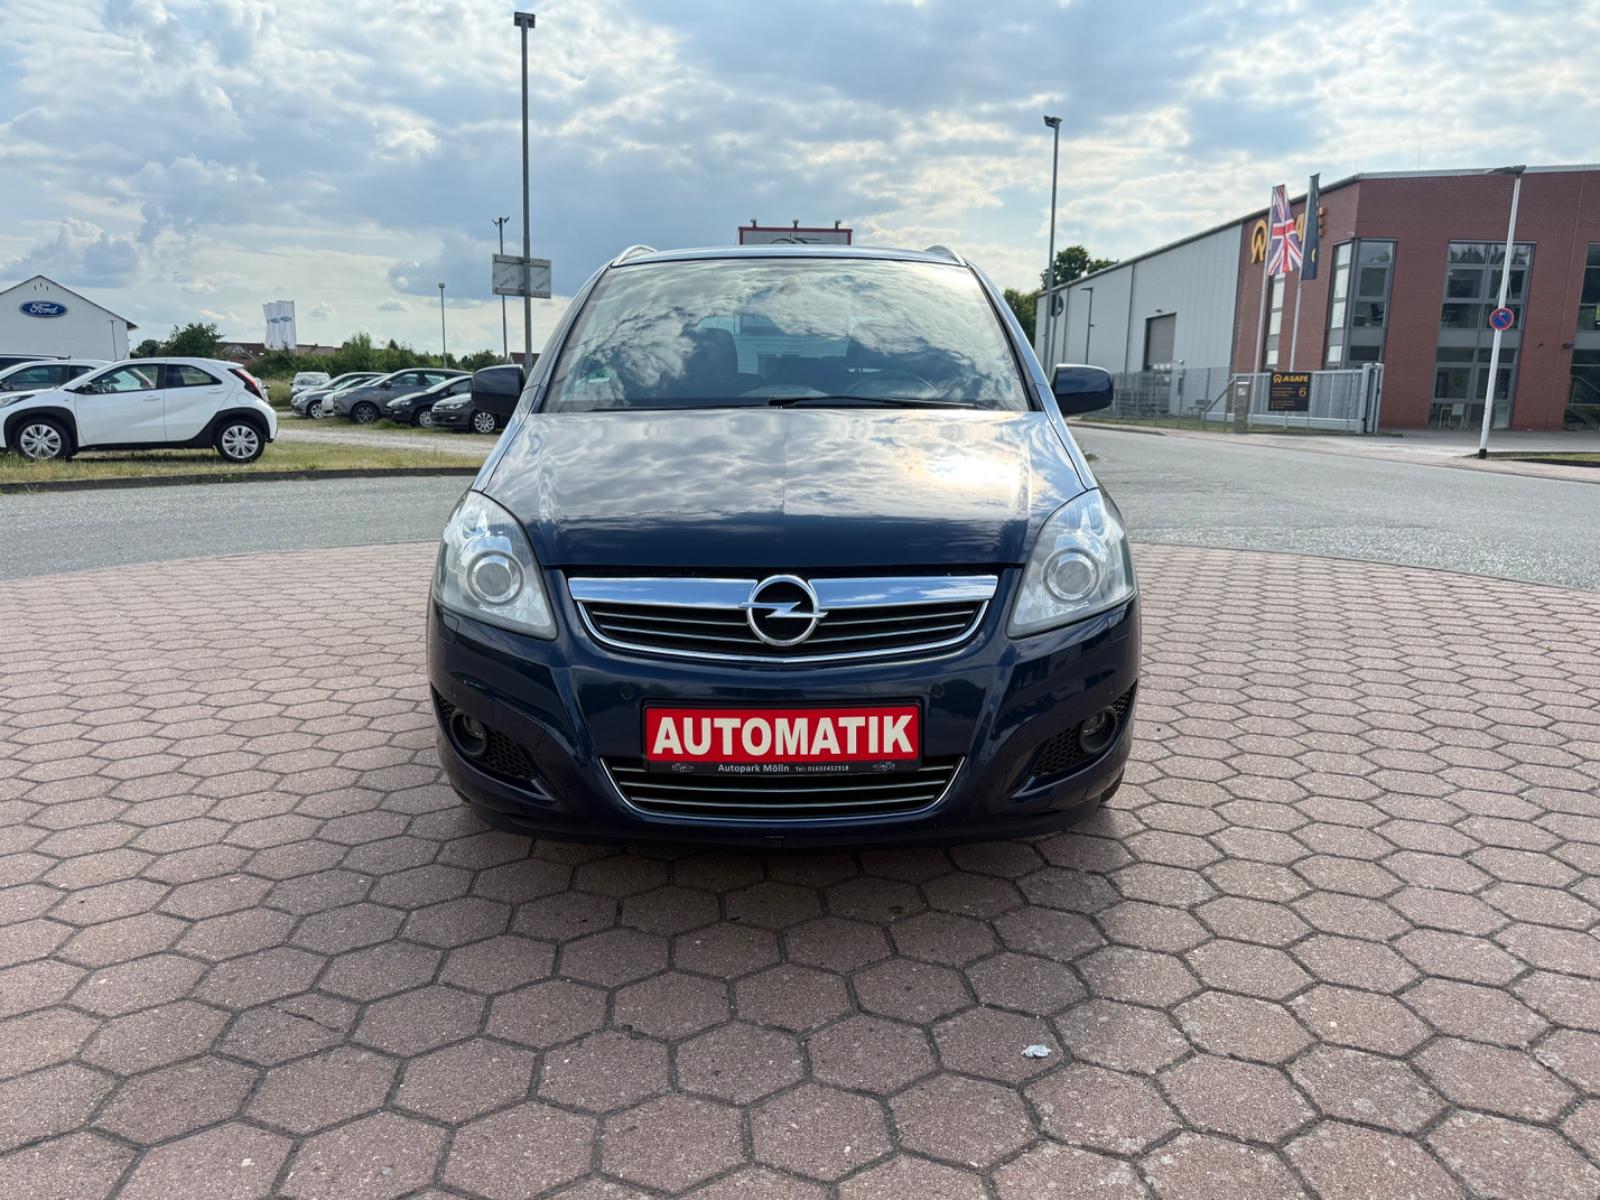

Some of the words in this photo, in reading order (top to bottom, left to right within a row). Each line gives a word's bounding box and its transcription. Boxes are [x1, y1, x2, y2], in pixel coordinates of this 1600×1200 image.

[30, 303, 58, 314] Ford
[1299, 386, 1307, 397] 6
[652, 714, 914, 757] AUTOMATIK
[718, 763, 760, 773] Autopark
[763, 763, 790, 772] Mölln
